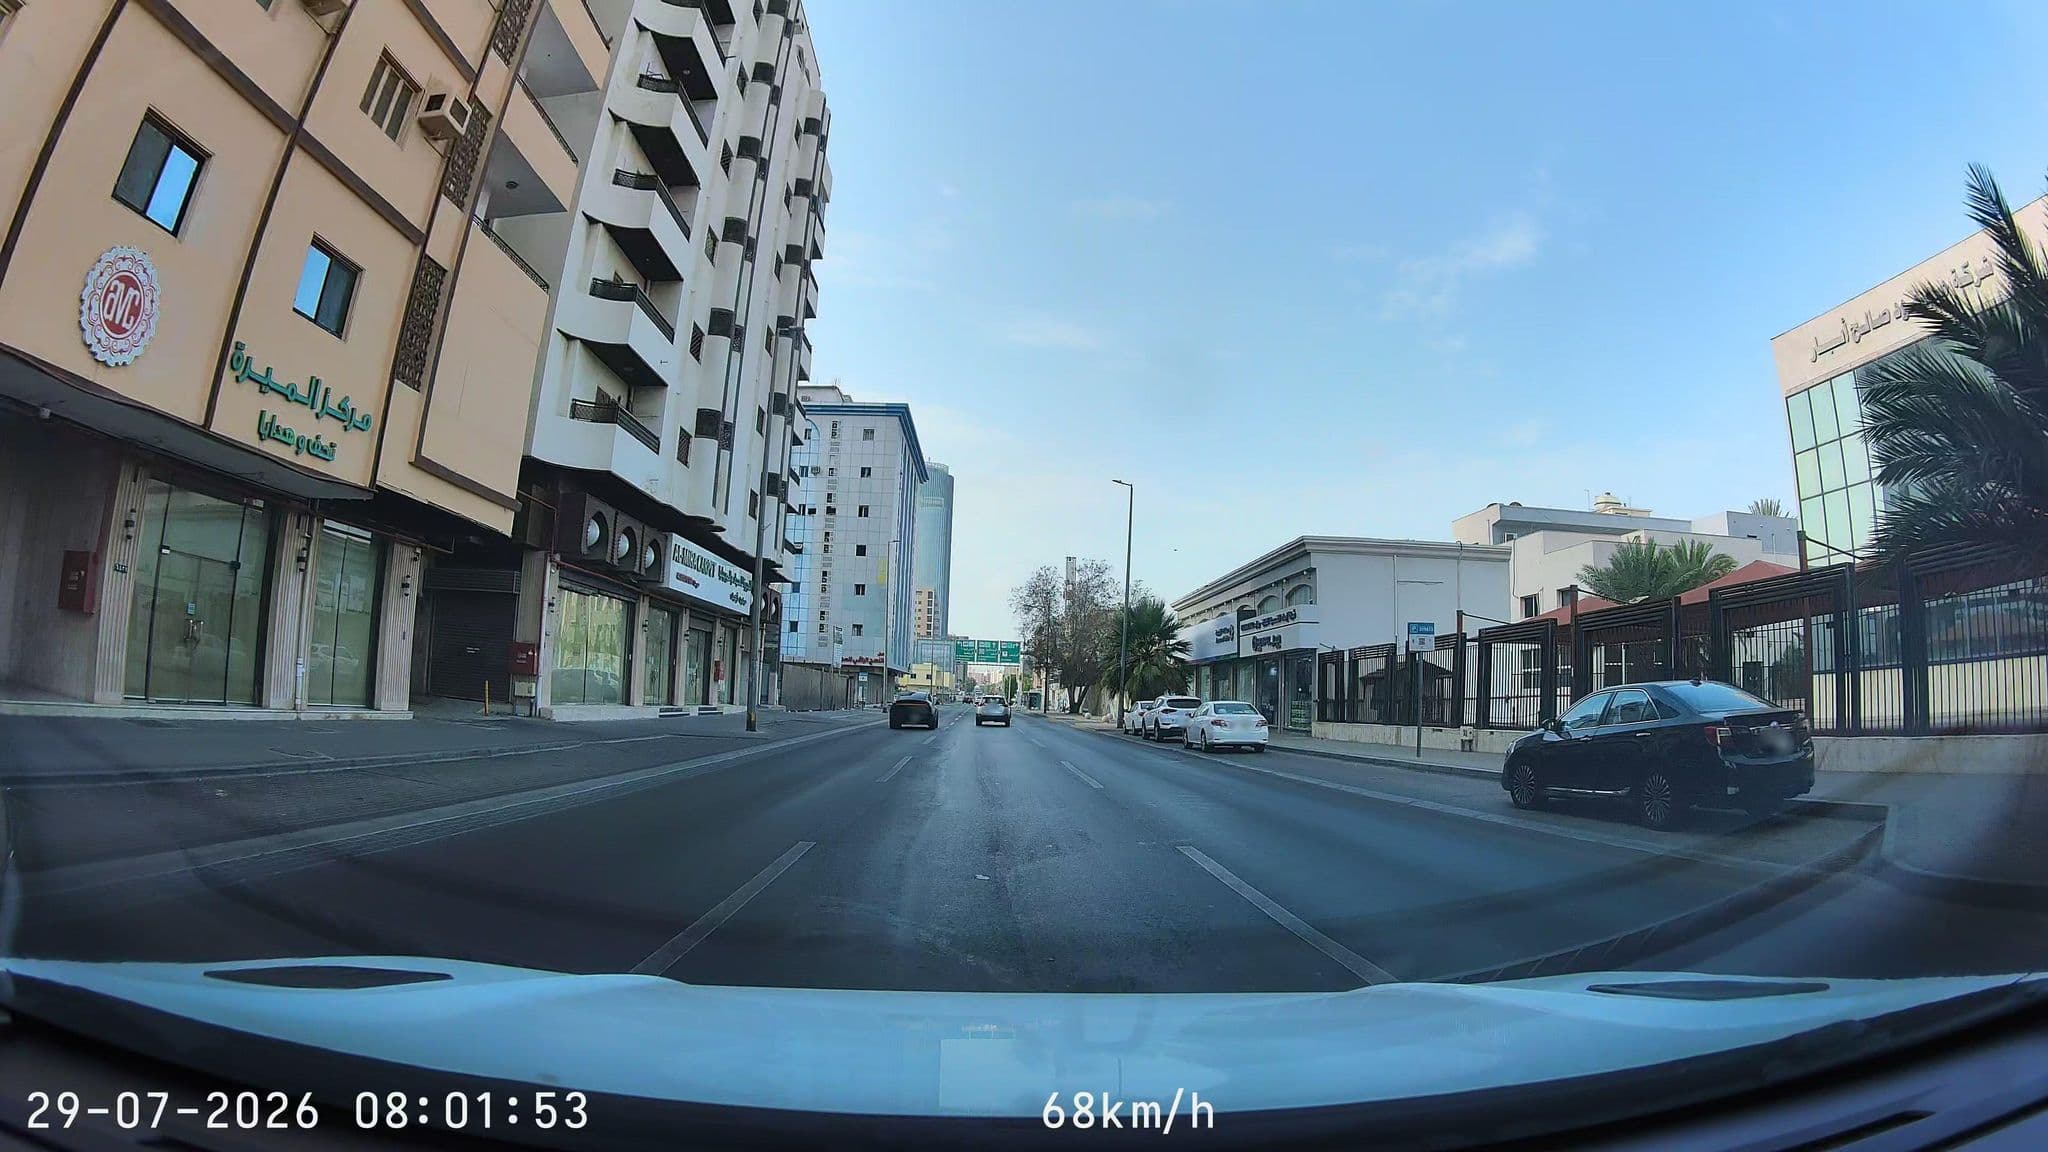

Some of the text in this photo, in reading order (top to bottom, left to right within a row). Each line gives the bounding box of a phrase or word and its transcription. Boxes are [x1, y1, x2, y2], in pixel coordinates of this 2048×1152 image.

[1951, 254, 1994, 289] شركة
[1850, 307, 1892, 344] صالح
[315, 386, 372, 432] مركز
[257, 410, 296, 446] هدايا
[306, 434, 337, 462] تحف
